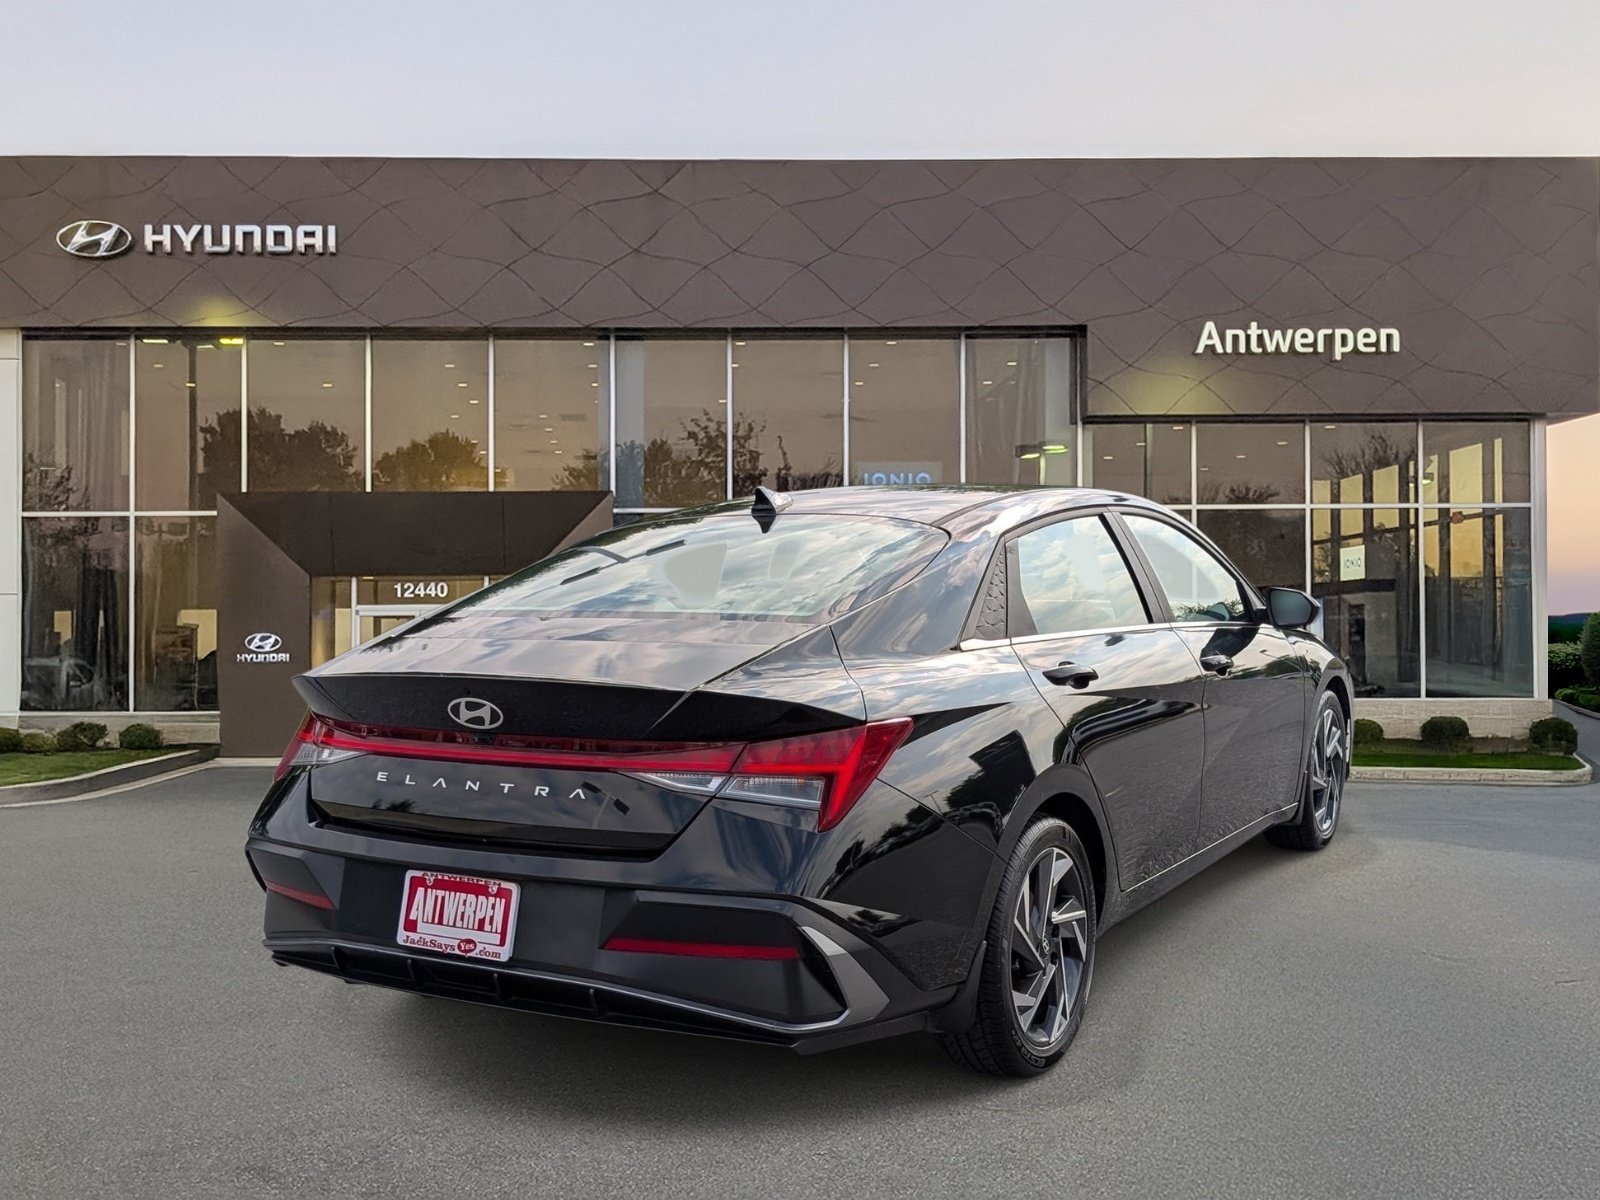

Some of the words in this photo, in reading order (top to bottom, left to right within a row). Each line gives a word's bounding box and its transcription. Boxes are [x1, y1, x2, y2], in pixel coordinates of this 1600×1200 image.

[144, 224, 336, 254] HYUNDAI
[1195, 321, 1400, 361] Antwerpen
[394, 582, 448, 598] 12440
[236, 653, 290, 663] HYUNDAI
[376, 771, 586, 800] ELANTRA
[421, 872, 502, 887] ANTWERPEN
[409, 887, 506, 933] ANTWERPEN
